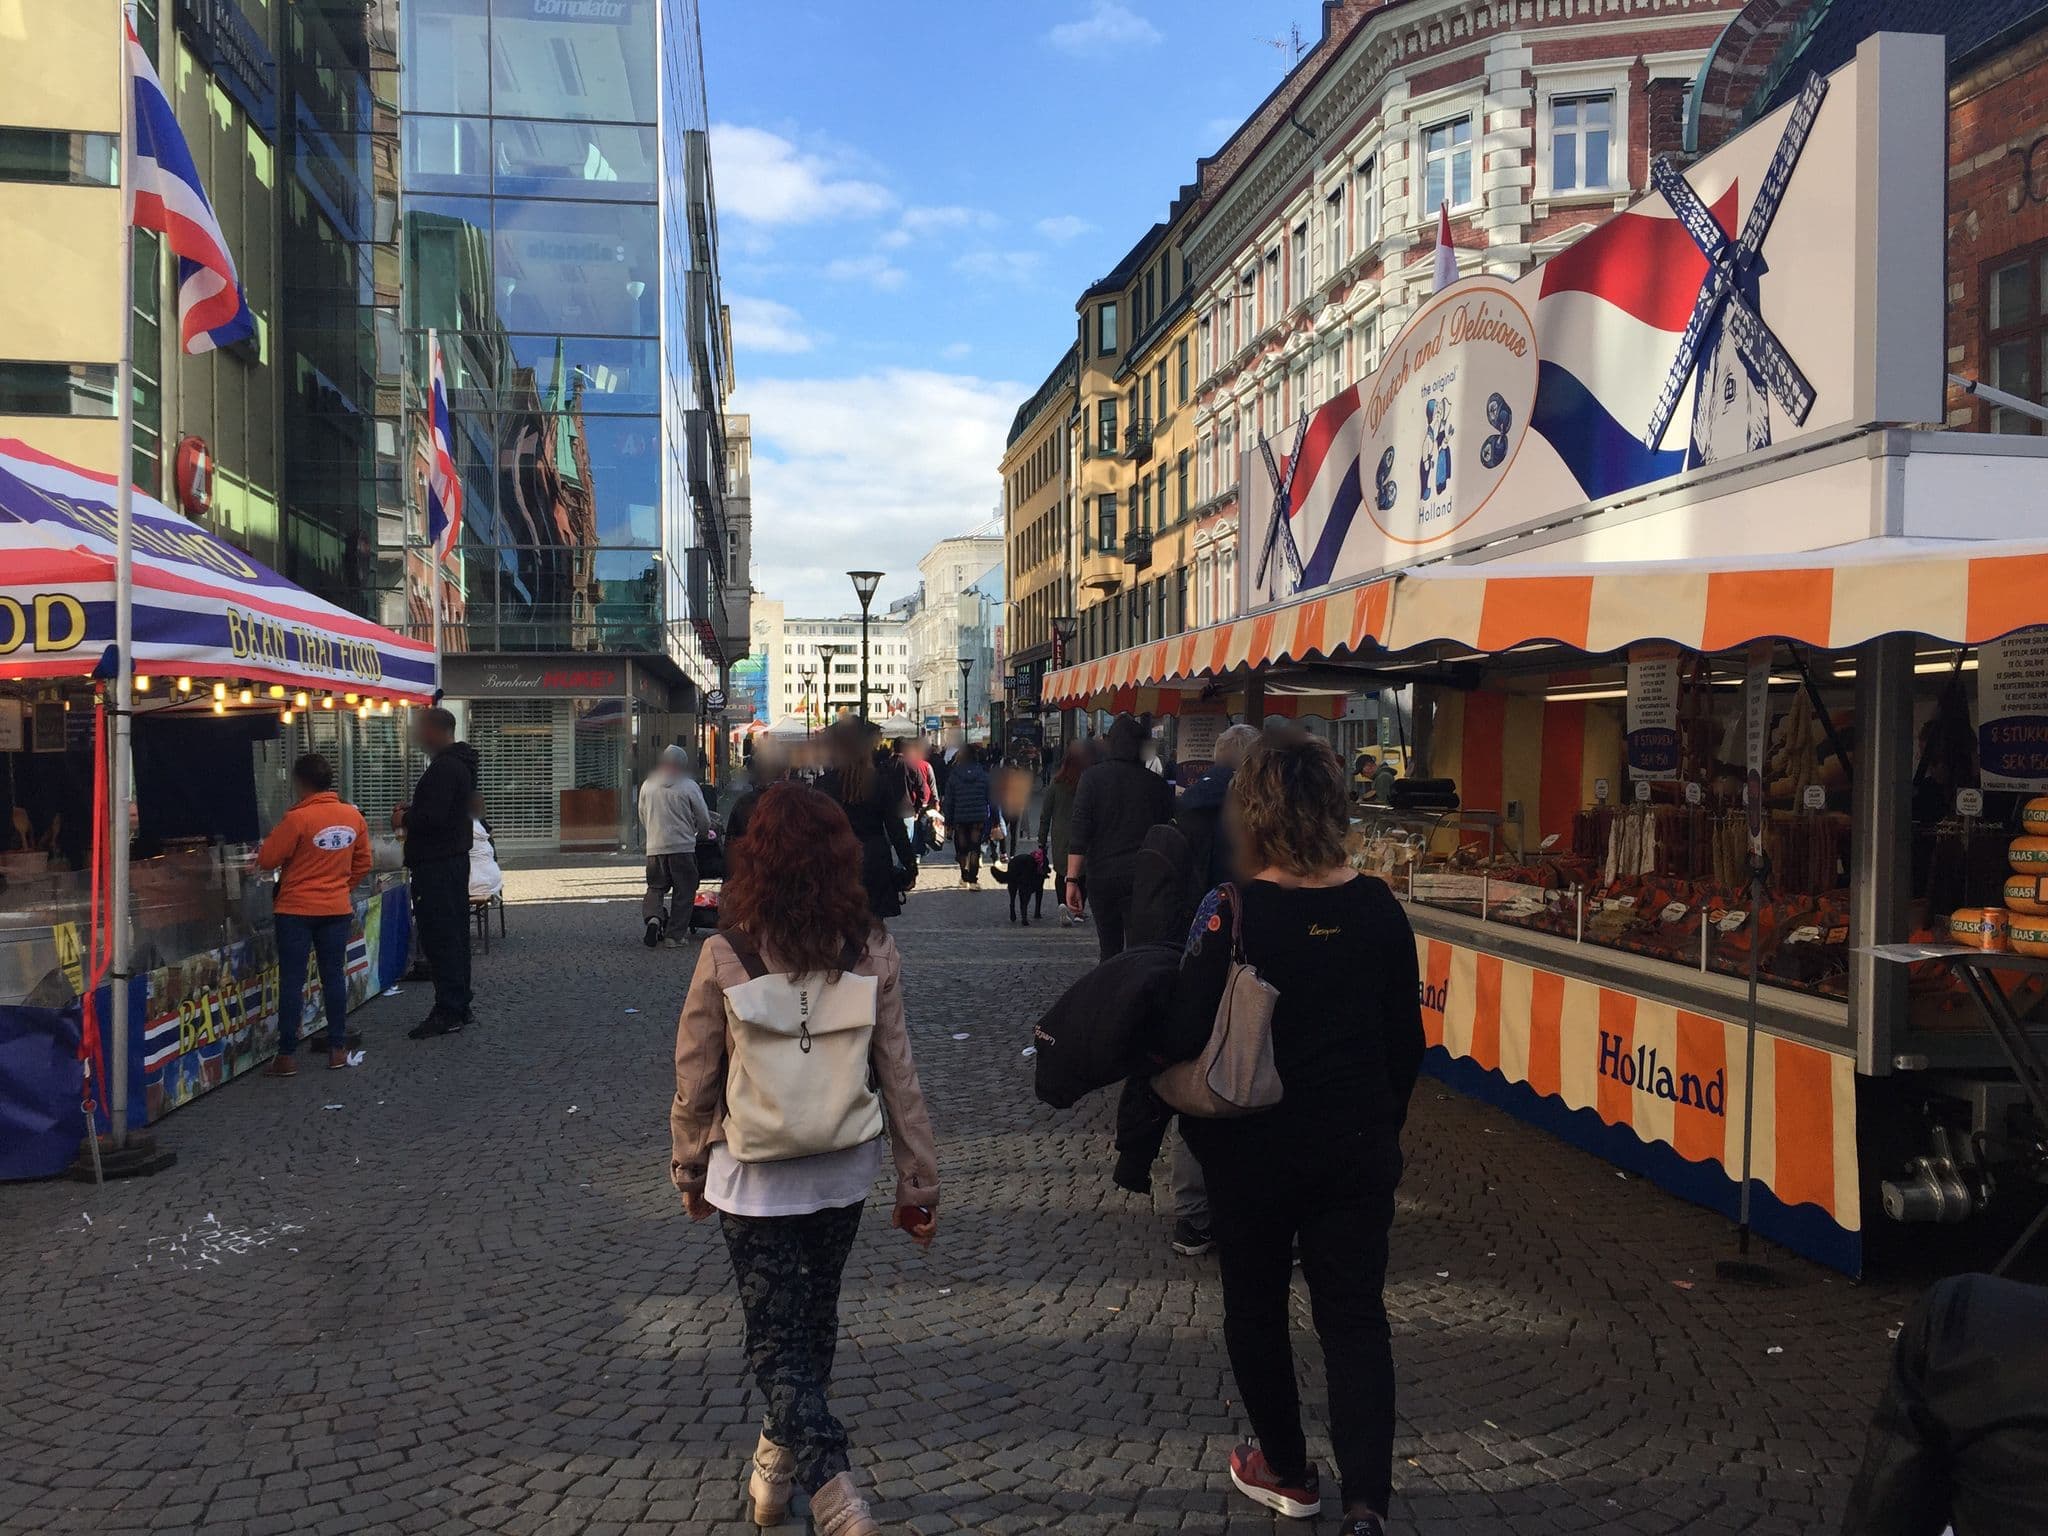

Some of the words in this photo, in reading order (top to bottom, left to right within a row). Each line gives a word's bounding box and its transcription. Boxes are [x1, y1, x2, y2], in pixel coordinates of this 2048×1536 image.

[1369, 347, 1409, 439] Dutch
[1413, 314, 1446, 373] and
[1448, 300, 1528, 358] Delicious
[1420, 382, 1432, 399] the
[1432, 367, 1457, 394] original
[1418, 495, 1453, 526] Holland
[227, 606, 291, 667] BAAN
[292, 626, 336, 675] THAI
[337, 637, 382, 681] FOOD
[481, 672, 543, 688] Bernhard
[800, 991, 809, 1016] SLANG
[1599, 1030, 1724, 1117] Holland
